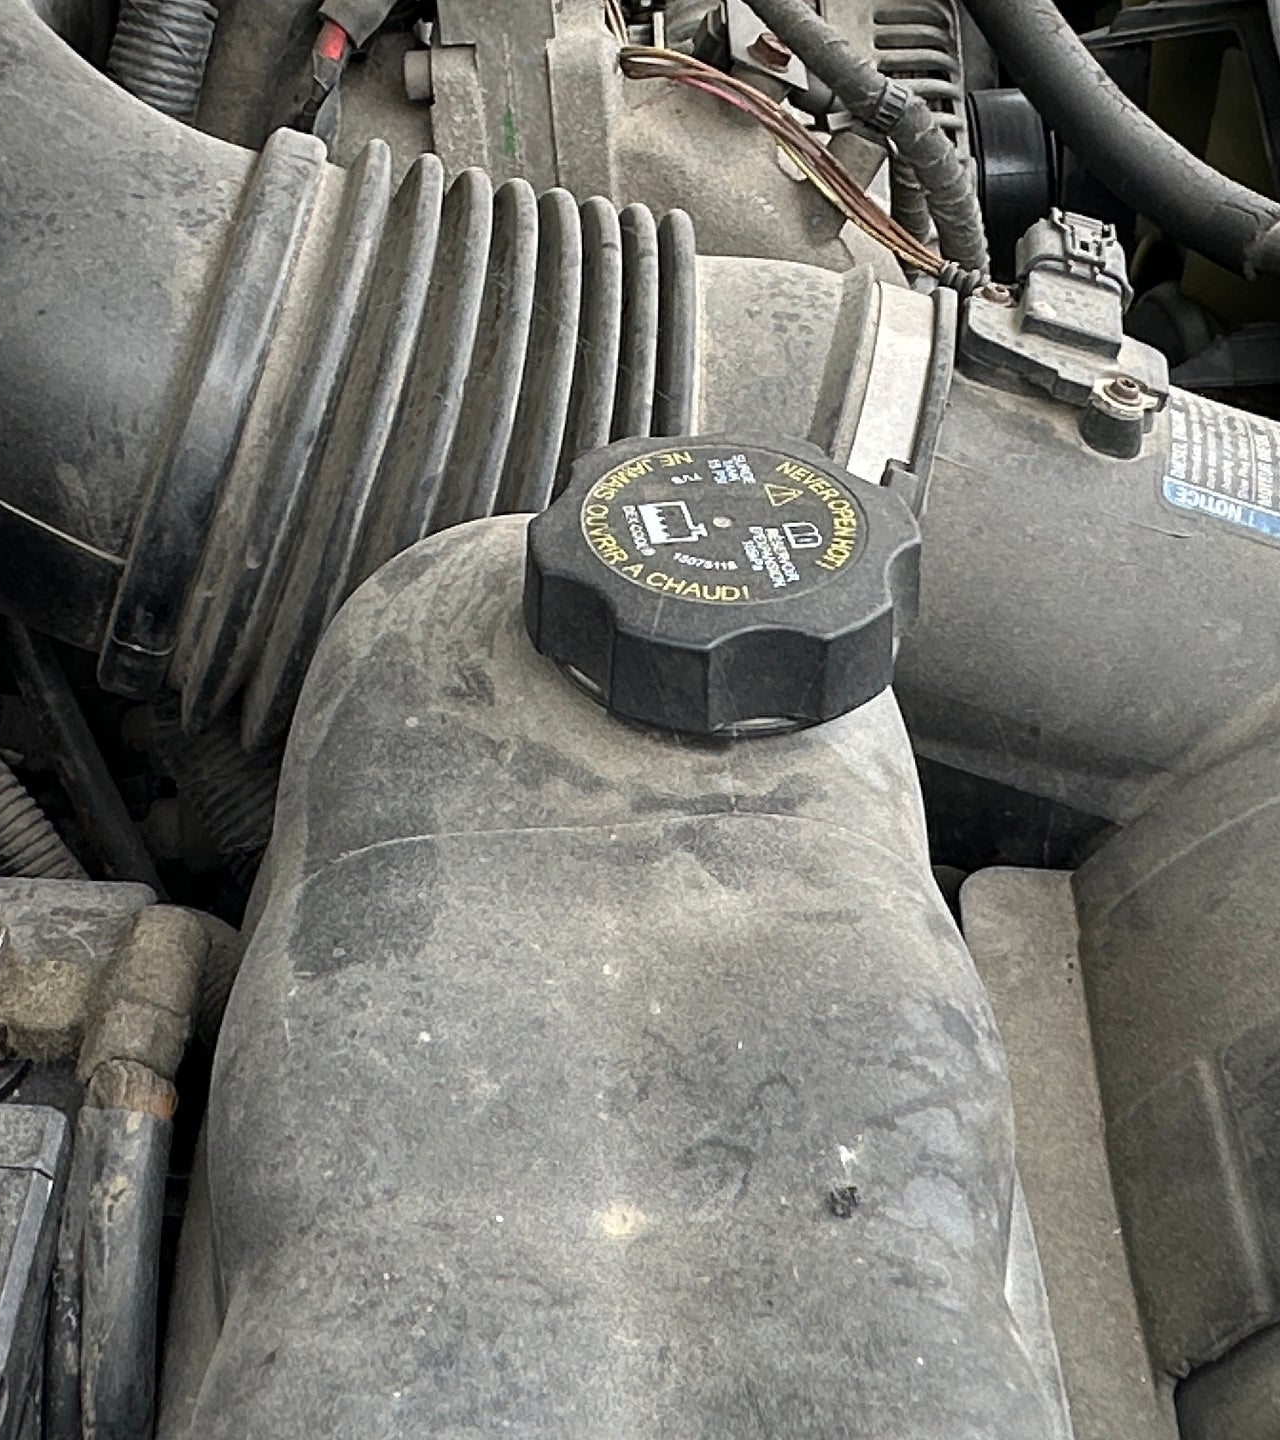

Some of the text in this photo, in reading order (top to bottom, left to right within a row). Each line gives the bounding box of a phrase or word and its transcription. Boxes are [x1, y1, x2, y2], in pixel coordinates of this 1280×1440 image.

[593, 454, 655, 501] JAMAIS
[662, 450, 694, 470] NE
[776, 459, 840, 502] NEVER
[828, 498, 860, 539] OPEN
[1176, 486, 1243, 525] NOTICE
[586, 502, 630, 566] OUVRIR
